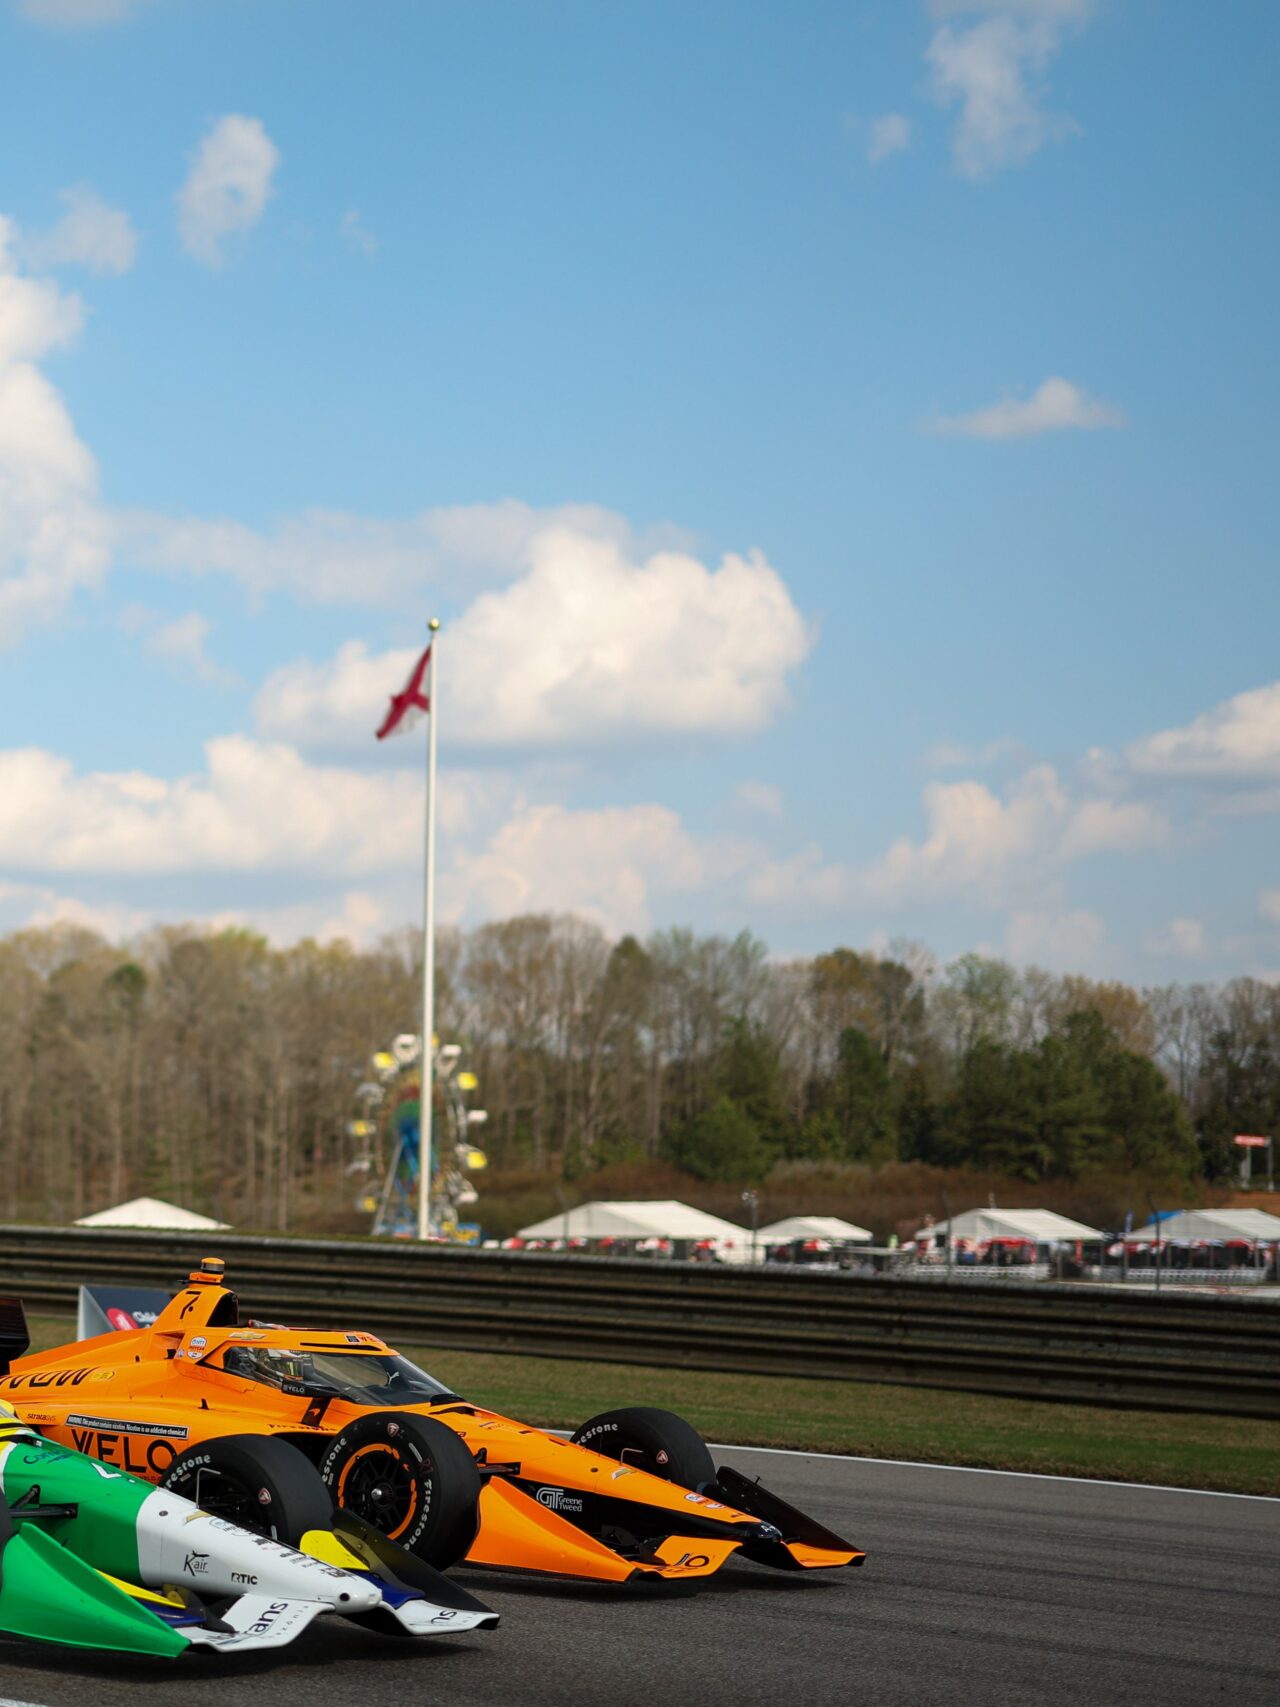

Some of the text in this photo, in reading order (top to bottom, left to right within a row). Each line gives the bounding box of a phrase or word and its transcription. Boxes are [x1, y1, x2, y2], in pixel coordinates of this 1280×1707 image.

[180, 1291, 201, 1319] 7
[71, 1428, 177, 1475] VELO
[321, 1437, 347, 1483] estone
[165, 1454, 211, 1489] restone
[402, 1478, 433, 1551] Firestone
[558, 1496, 583, 1505] Greene
[558, 1501, 583, 1512] Tweed
[231, 1572, 258, 1585] RTIC
